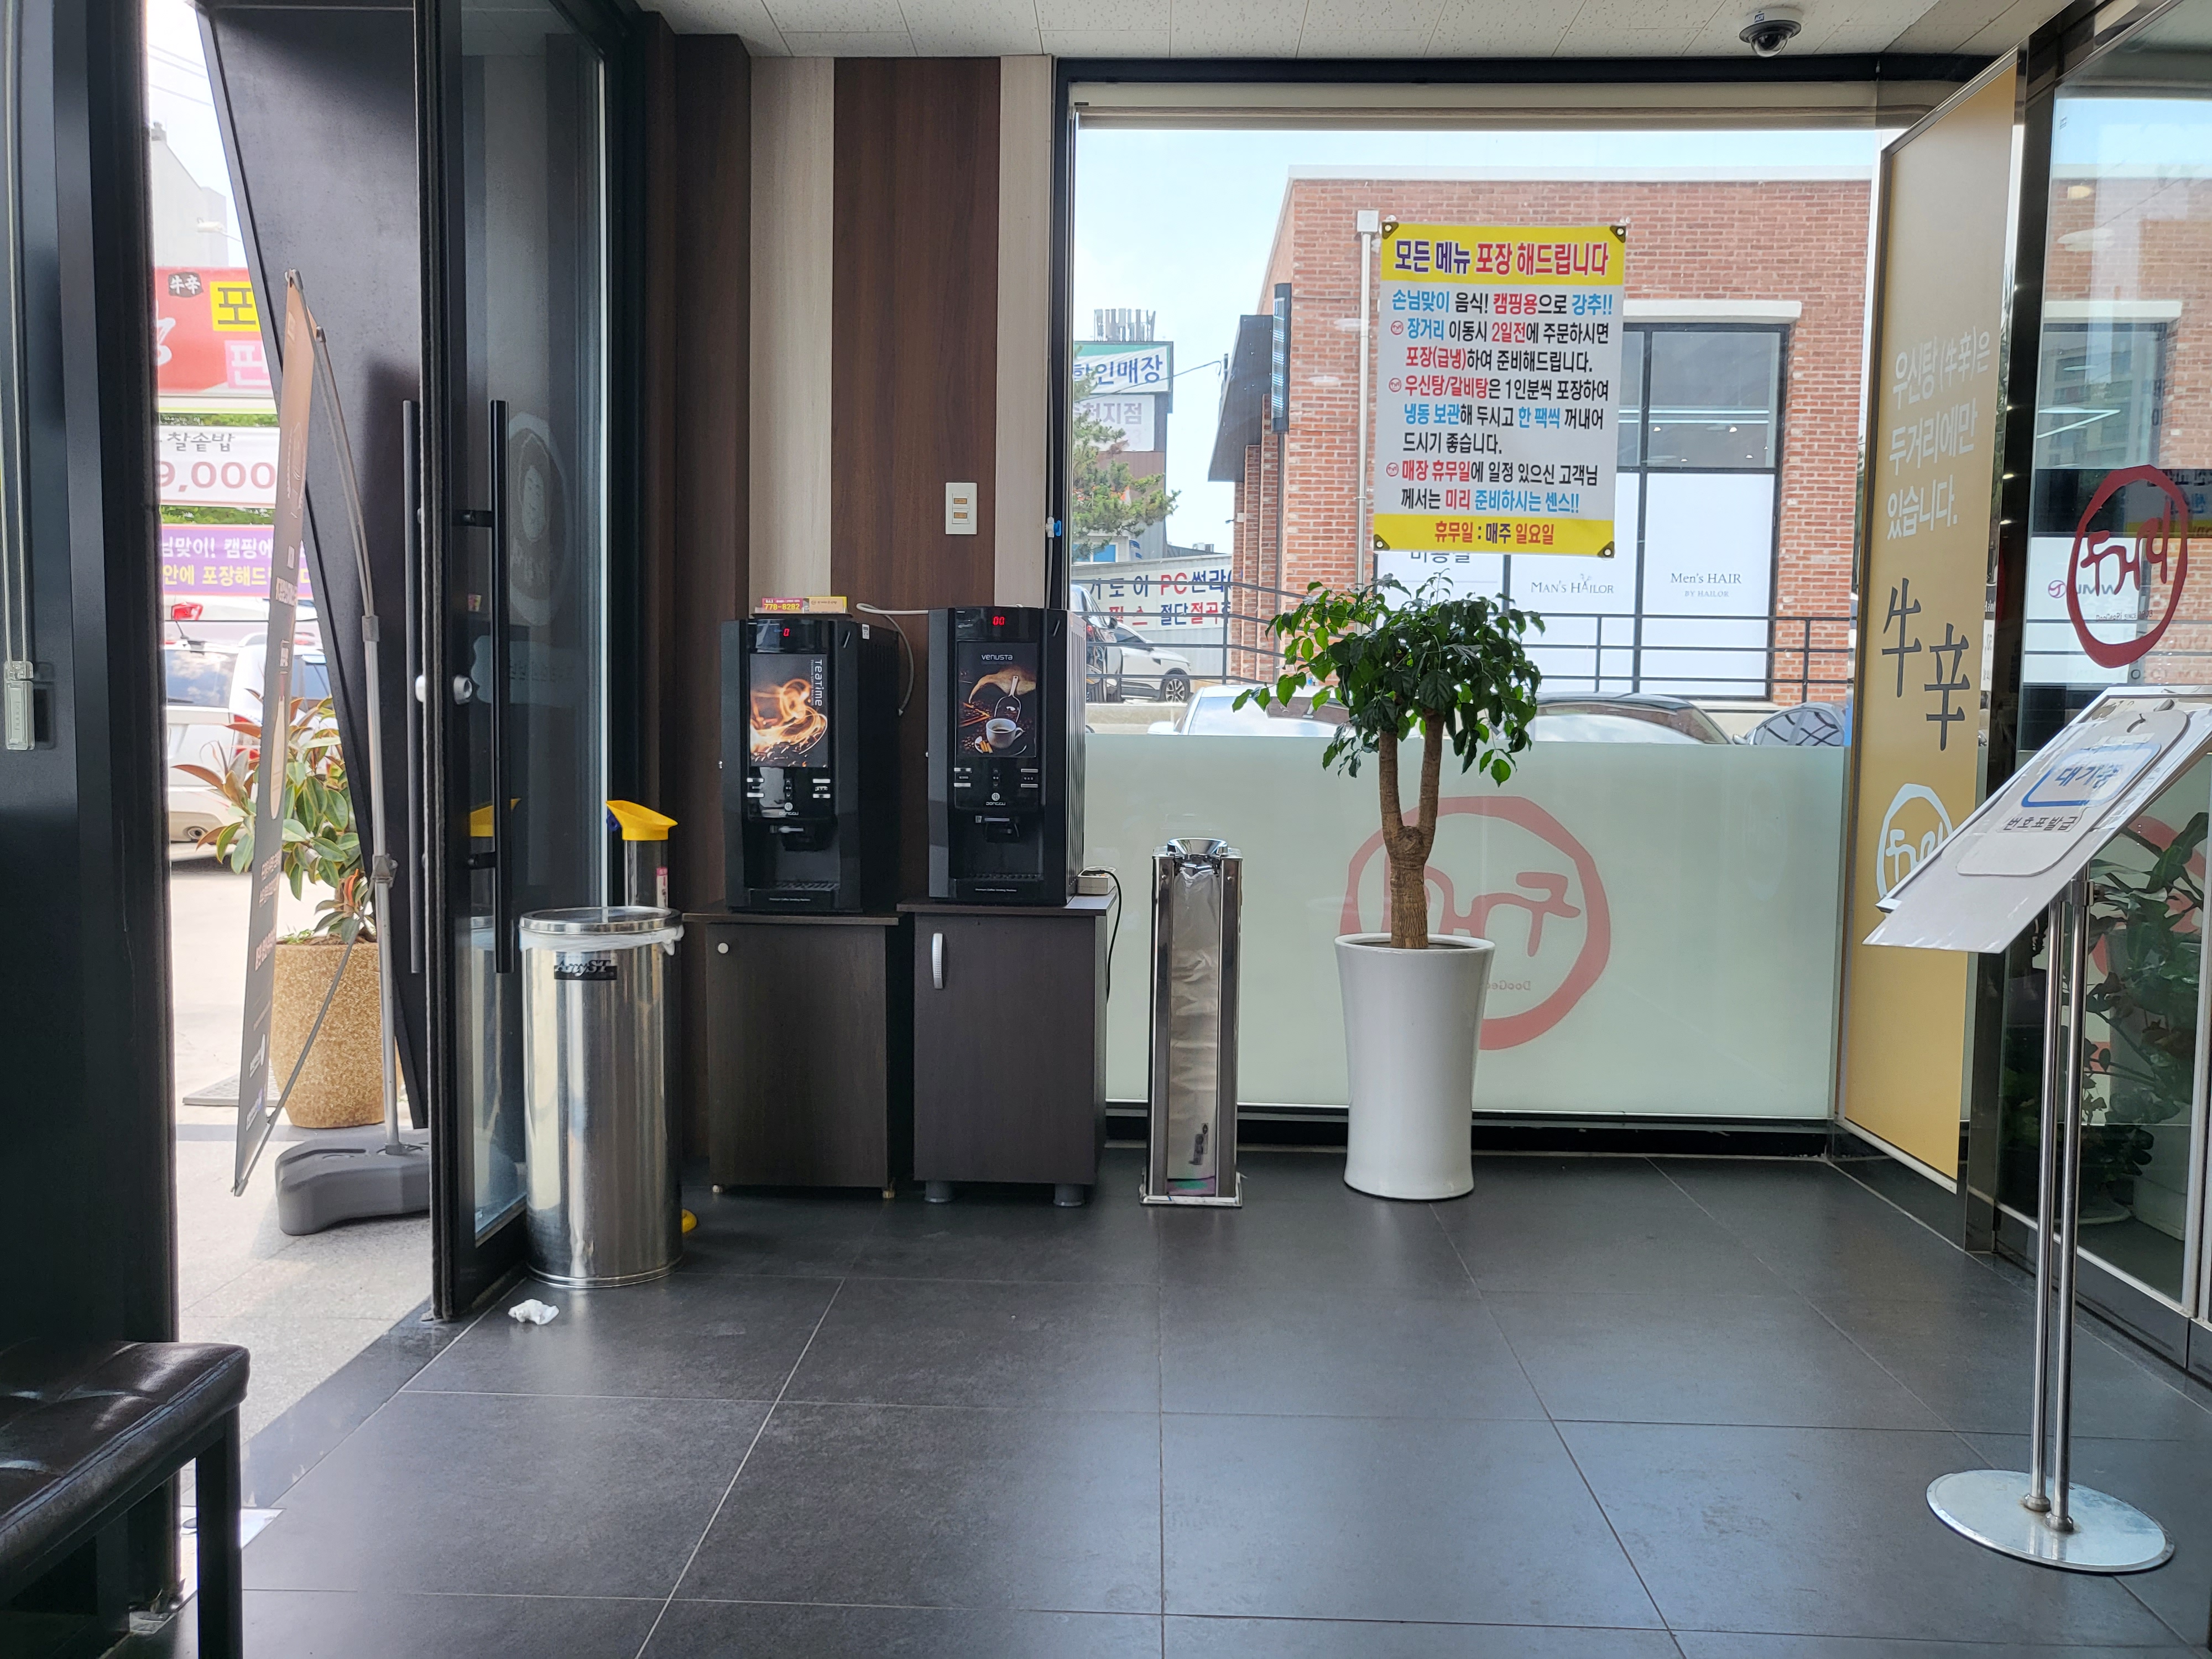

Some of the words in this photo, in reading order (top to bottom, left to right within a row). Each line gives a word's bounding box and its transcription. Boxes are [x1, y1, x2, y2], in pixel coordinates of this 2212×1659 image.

[1395, 240, 1430, 273] 모든
[1436, 242, 1470, 274] 메뉴
[1476, 243, 1512, 275] 포장
[1517, 243, 1608, 276] 해드립니다
[1392, 289, 1449, 313] 손님맞이
[1455, 293, 1488, 314] 음식!
[1494, 293, 1567, 315] 캠핑용으로
[1572, 294, 1613, 316] 강추!!
[1407, 318, 1444, 341] 장거리
[1449, 321, 1486, 343] 이동시
[1492, 322, 1539, 343] 2일전에
[1543, 322, 1609, 345] 주문하시면
[1406, 346, 1492, 370] 포장(급냉)하여
[1497, 349, 1593, 372] 준비해드립니다.
[1405, 375, 1501, 400] 우신탕/갈비탕은
[1505, 379, 1552, 400] 1인분씩
[1557, 380, 1609, 401] 포장하여
[1404, 403, 1430, 425] 냉동
[1434, 404, 1472, 426] 보관해
[1477, 406, 1514, 427] 두시고
[1519, 406, 1531, 428] 한
[1535, 408, 1561, 429] 팩씩
[1564, 408, 1604, 430] 꺼내어
[1403, 432, 1441, 453] 드시기
[1446, 433, 1502, 455] 좋습니다.
[1890, 398, 1978, 476] 두거리에만
[1402, 460, 1427, 482] 매장
[1432, 461, 1484, 483] 휴무일에
[1489, 462, 1514, 483] 일정
[1518, 463, 1554, 485] 있으신
[1559, 465, 1598, 486] 고객님
[1401, 489, 1441, 510] 께서는
[1446, 489, 1470, 510] 미리
[1475, 490, 1541, 512] 준비하시는
[1545, 492, 1579, 513] 센스!!
[1887, 474, 1958, 540] 있습니다.
[1435, 521, 1473, 543] 휴무일
[1486, 523, 1511, 545] 매주
[1516, 524, 1554, 545] 일요일
[1670, 573, 1704, 584] Men's
[1707, 573, 1742, 585] HAIR
